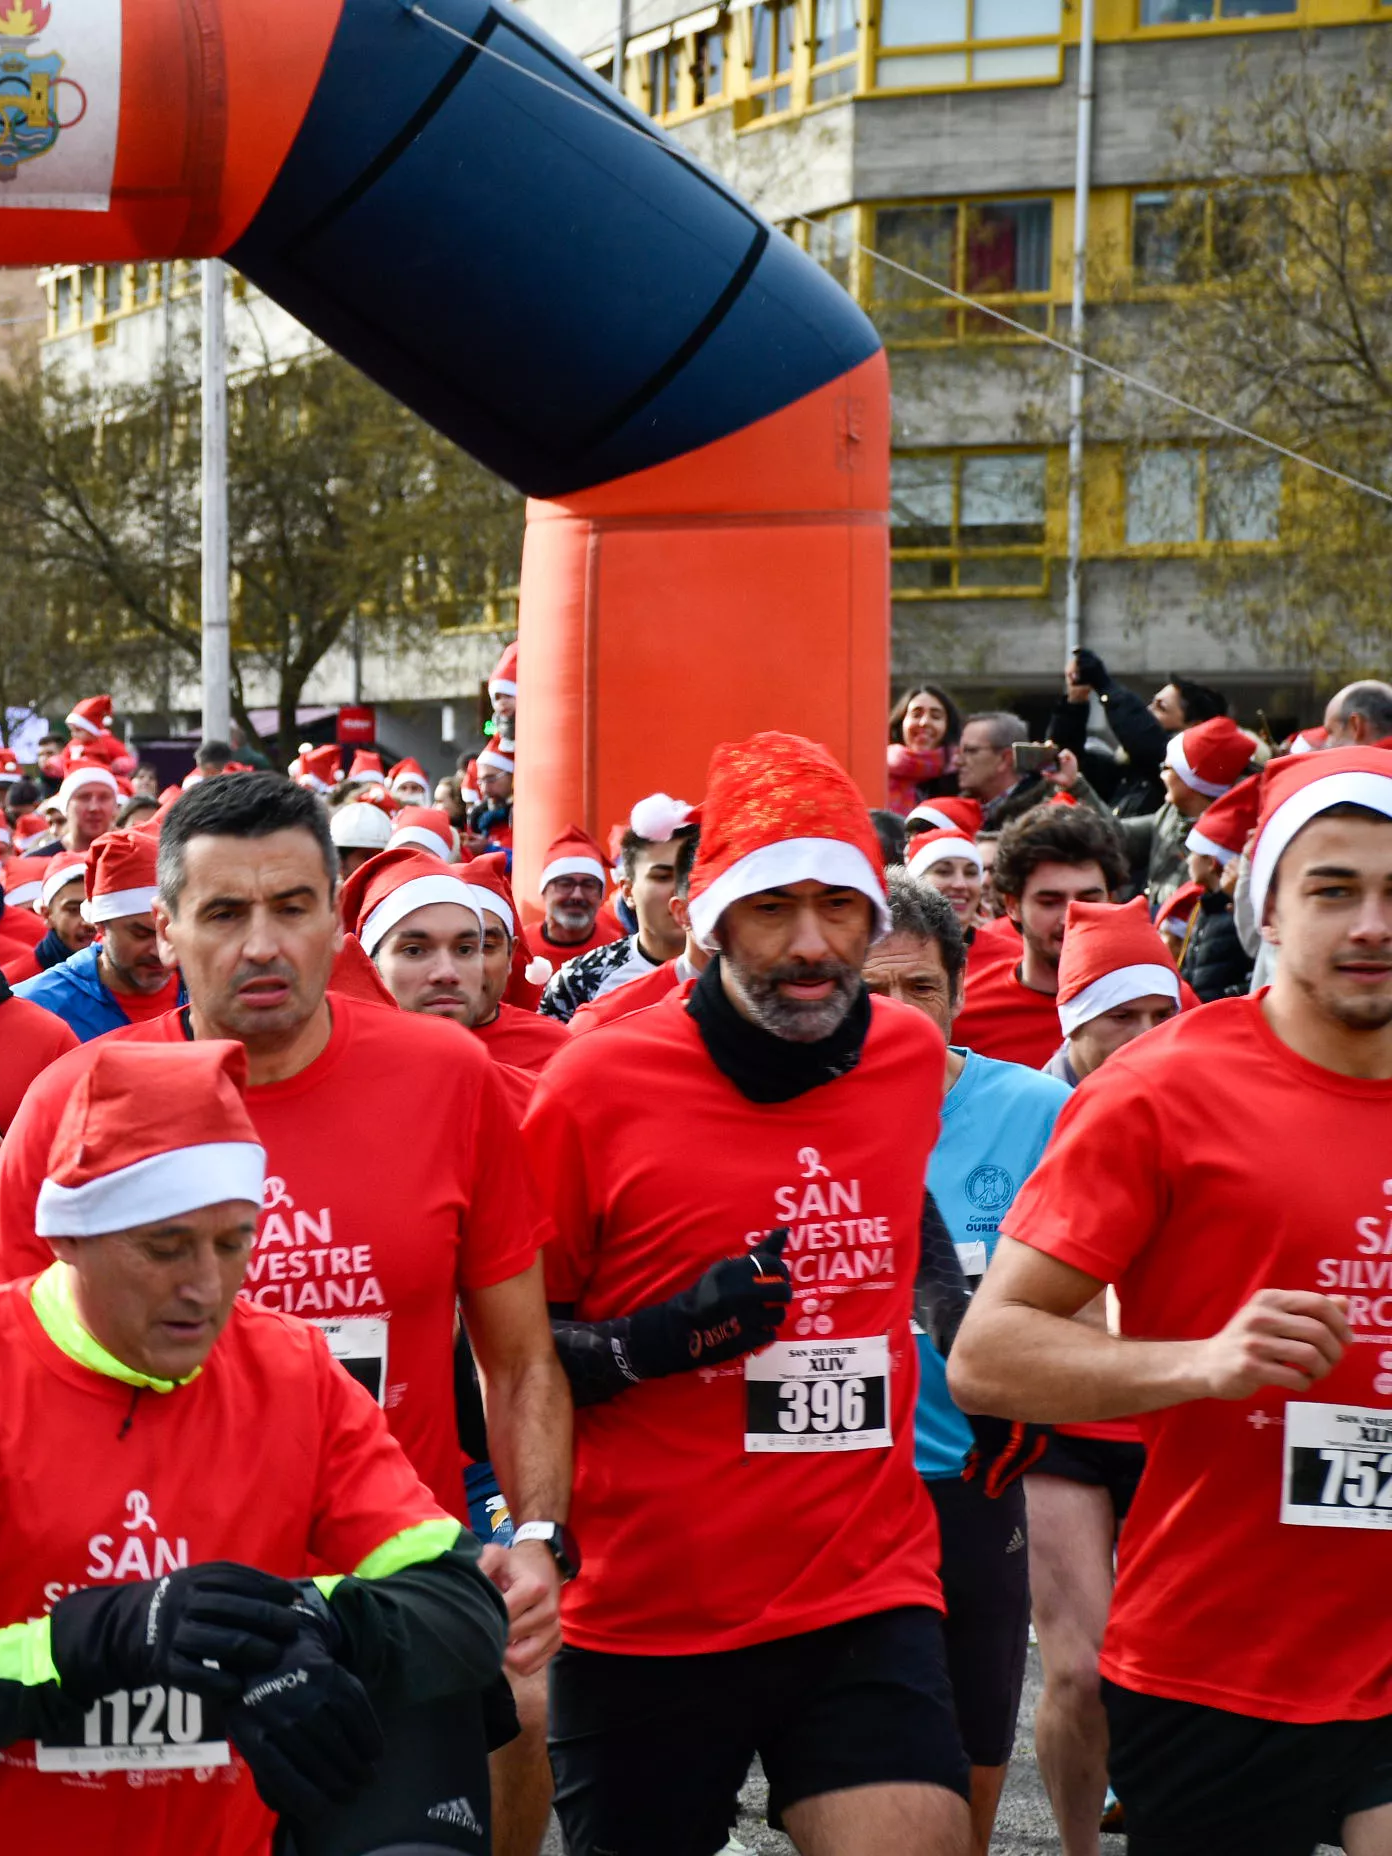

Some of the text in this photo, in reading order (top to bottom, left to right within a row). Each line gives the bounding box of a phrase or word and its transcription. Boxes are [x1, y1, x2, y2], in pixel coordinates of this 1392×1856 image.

[774, 1179, 862, 1222] SAN
[251, 1208, 333, 1250] AN
[244, 1245, 372, 1282] VESTRE
[1316, 1258, 1392, 1289] SILV
[704, 1315, 741, 1348] asics
[788, 1346, 859, 1358] SAN SILVESTRE
[808, 1357, 847, 1372] XLIV
[777, 1378, 867, 1433] 396
[87, 1534, 188, 1581] SAN
[84, 1684, 203, 1747] 1120
[427, 1807, 484, 1837] adidas
